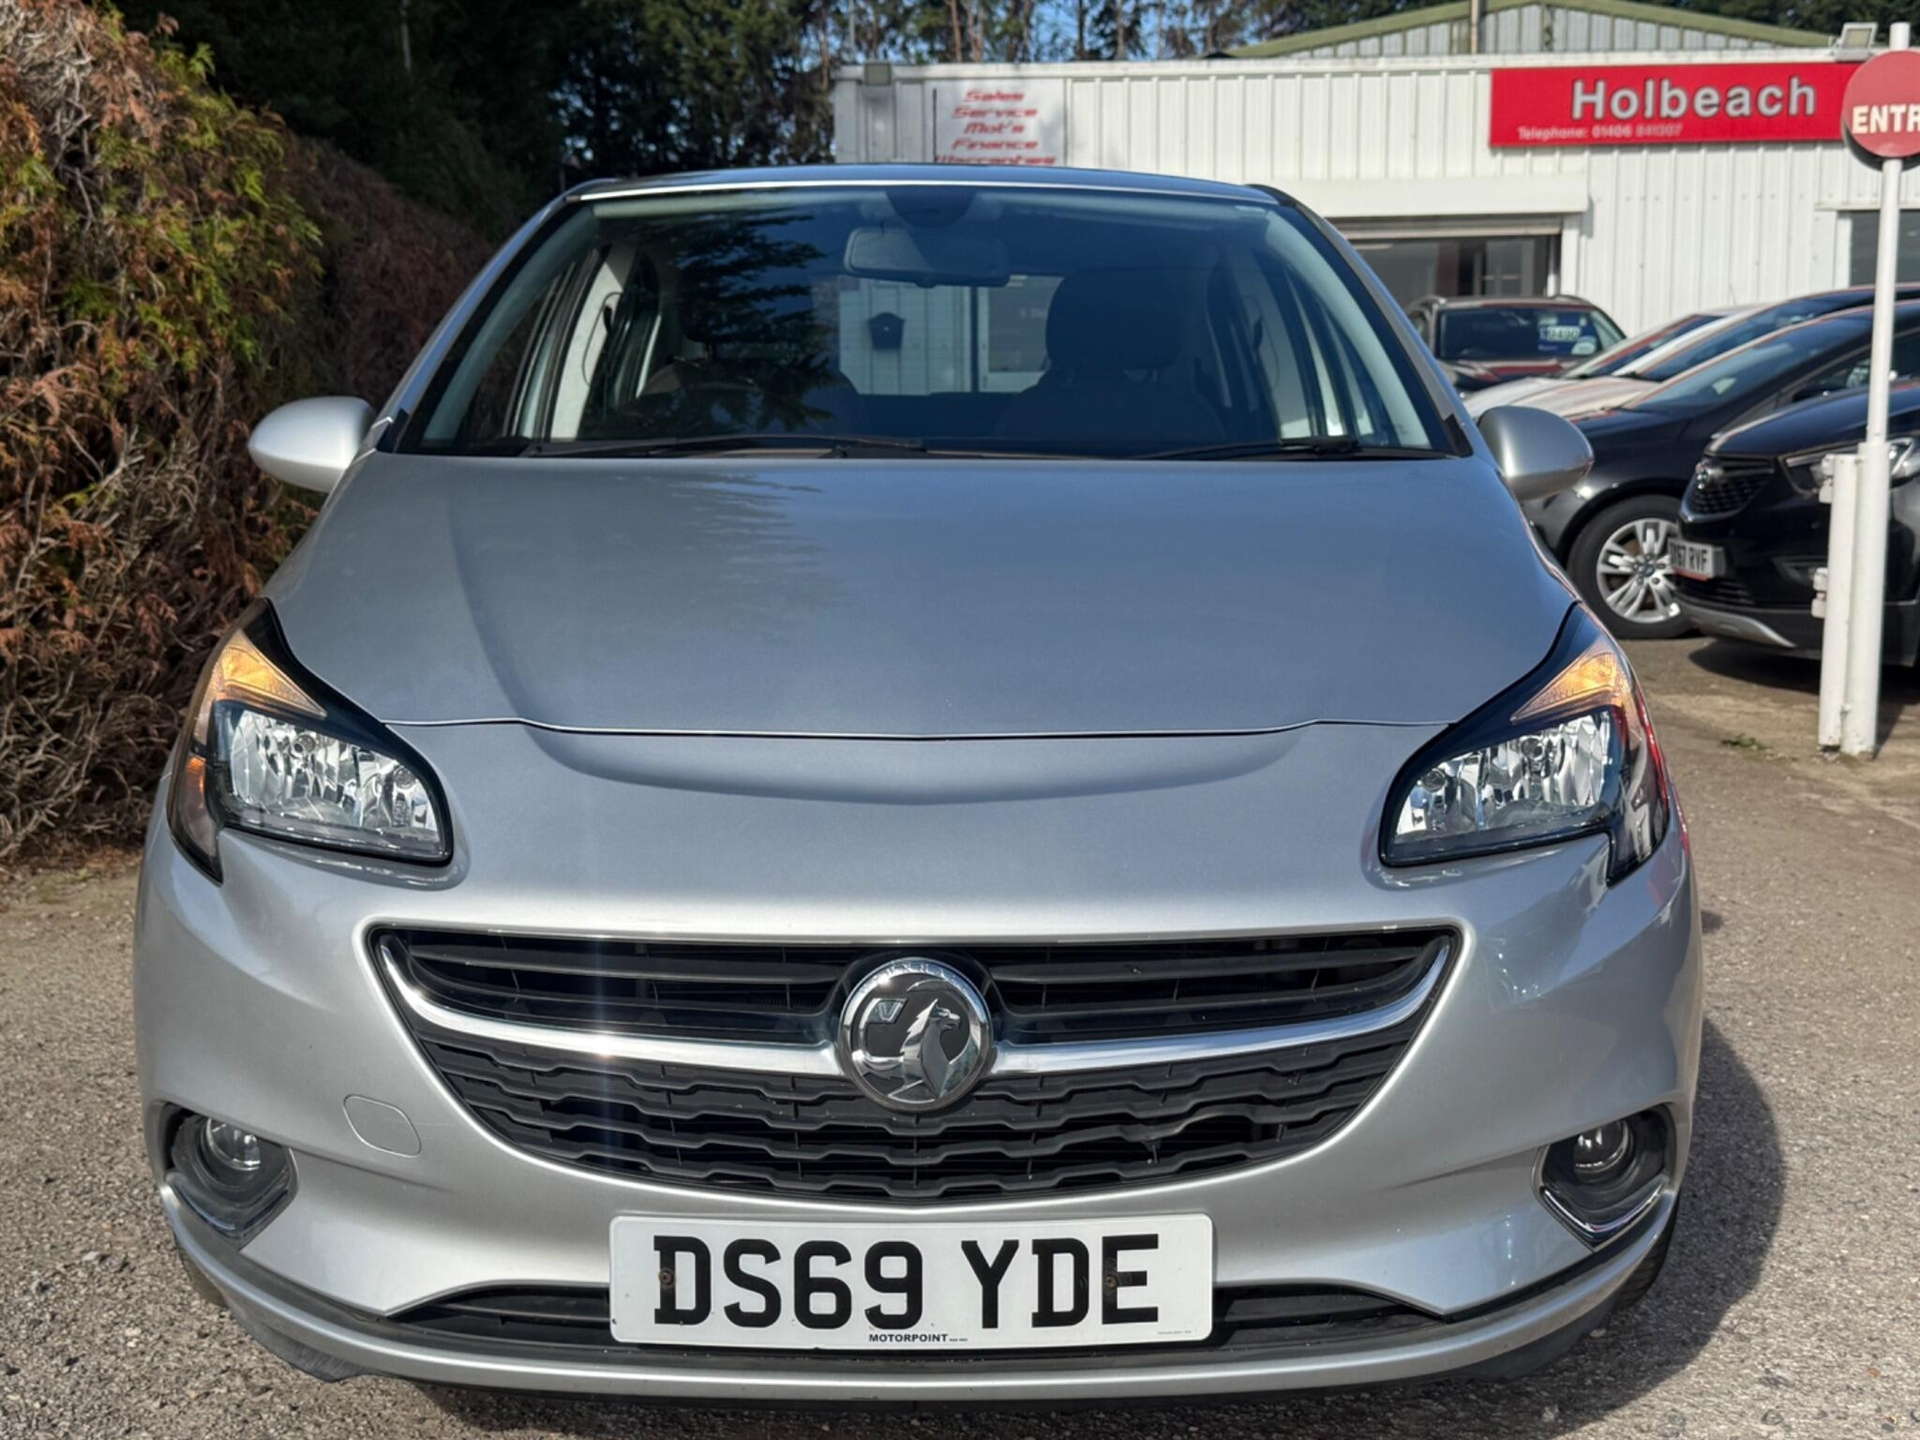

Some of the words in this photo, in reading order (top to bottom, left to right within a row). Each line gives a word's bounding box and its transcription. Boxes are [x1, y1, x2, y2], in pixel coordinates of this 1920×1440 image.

[964, 89, 1025, 102] Sales
[1571, 76, 1816, 120] Holbeach
[951, 105, 1038, 118] Service
[1851, 103, 1920, 134] ENTR
[1517, 126, 1588, 143] Telephone:
[951, 137, 1038, 150] Finance
[654, 1235, 922, 1330] DS69
[961, 1233, 1159, 1329] YDE
[869, 1333, 948, 1343] MOTORPOINT
